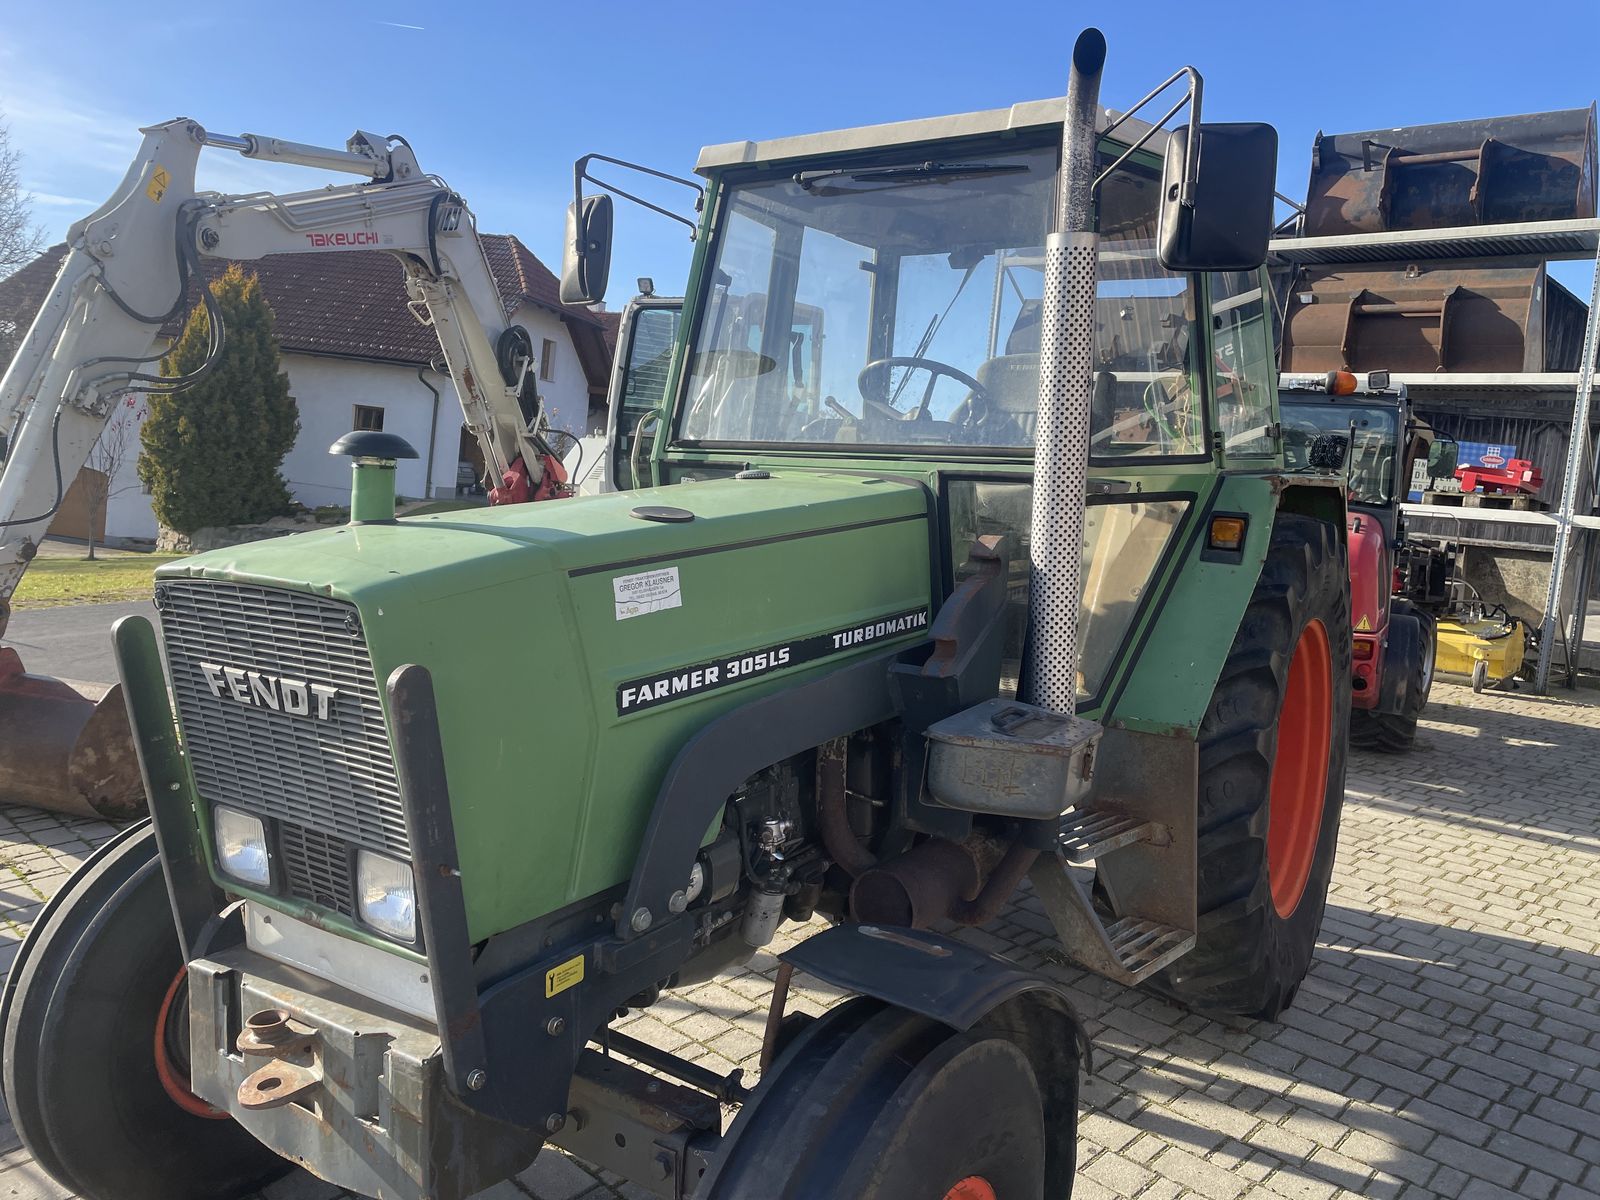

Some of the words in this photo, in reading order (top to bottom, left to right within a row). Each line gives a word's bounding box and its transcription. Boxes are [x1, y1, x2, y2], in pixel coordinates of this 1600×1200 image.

[619, 581, 644, 592] GREGOR
[644, 575, 674, 587] KLAUSNER
[621, 665, 719, 708] FARMER
[832, 611, 928, 649] TURBOMATIK
[200, 661, 339, 721] FENDT
